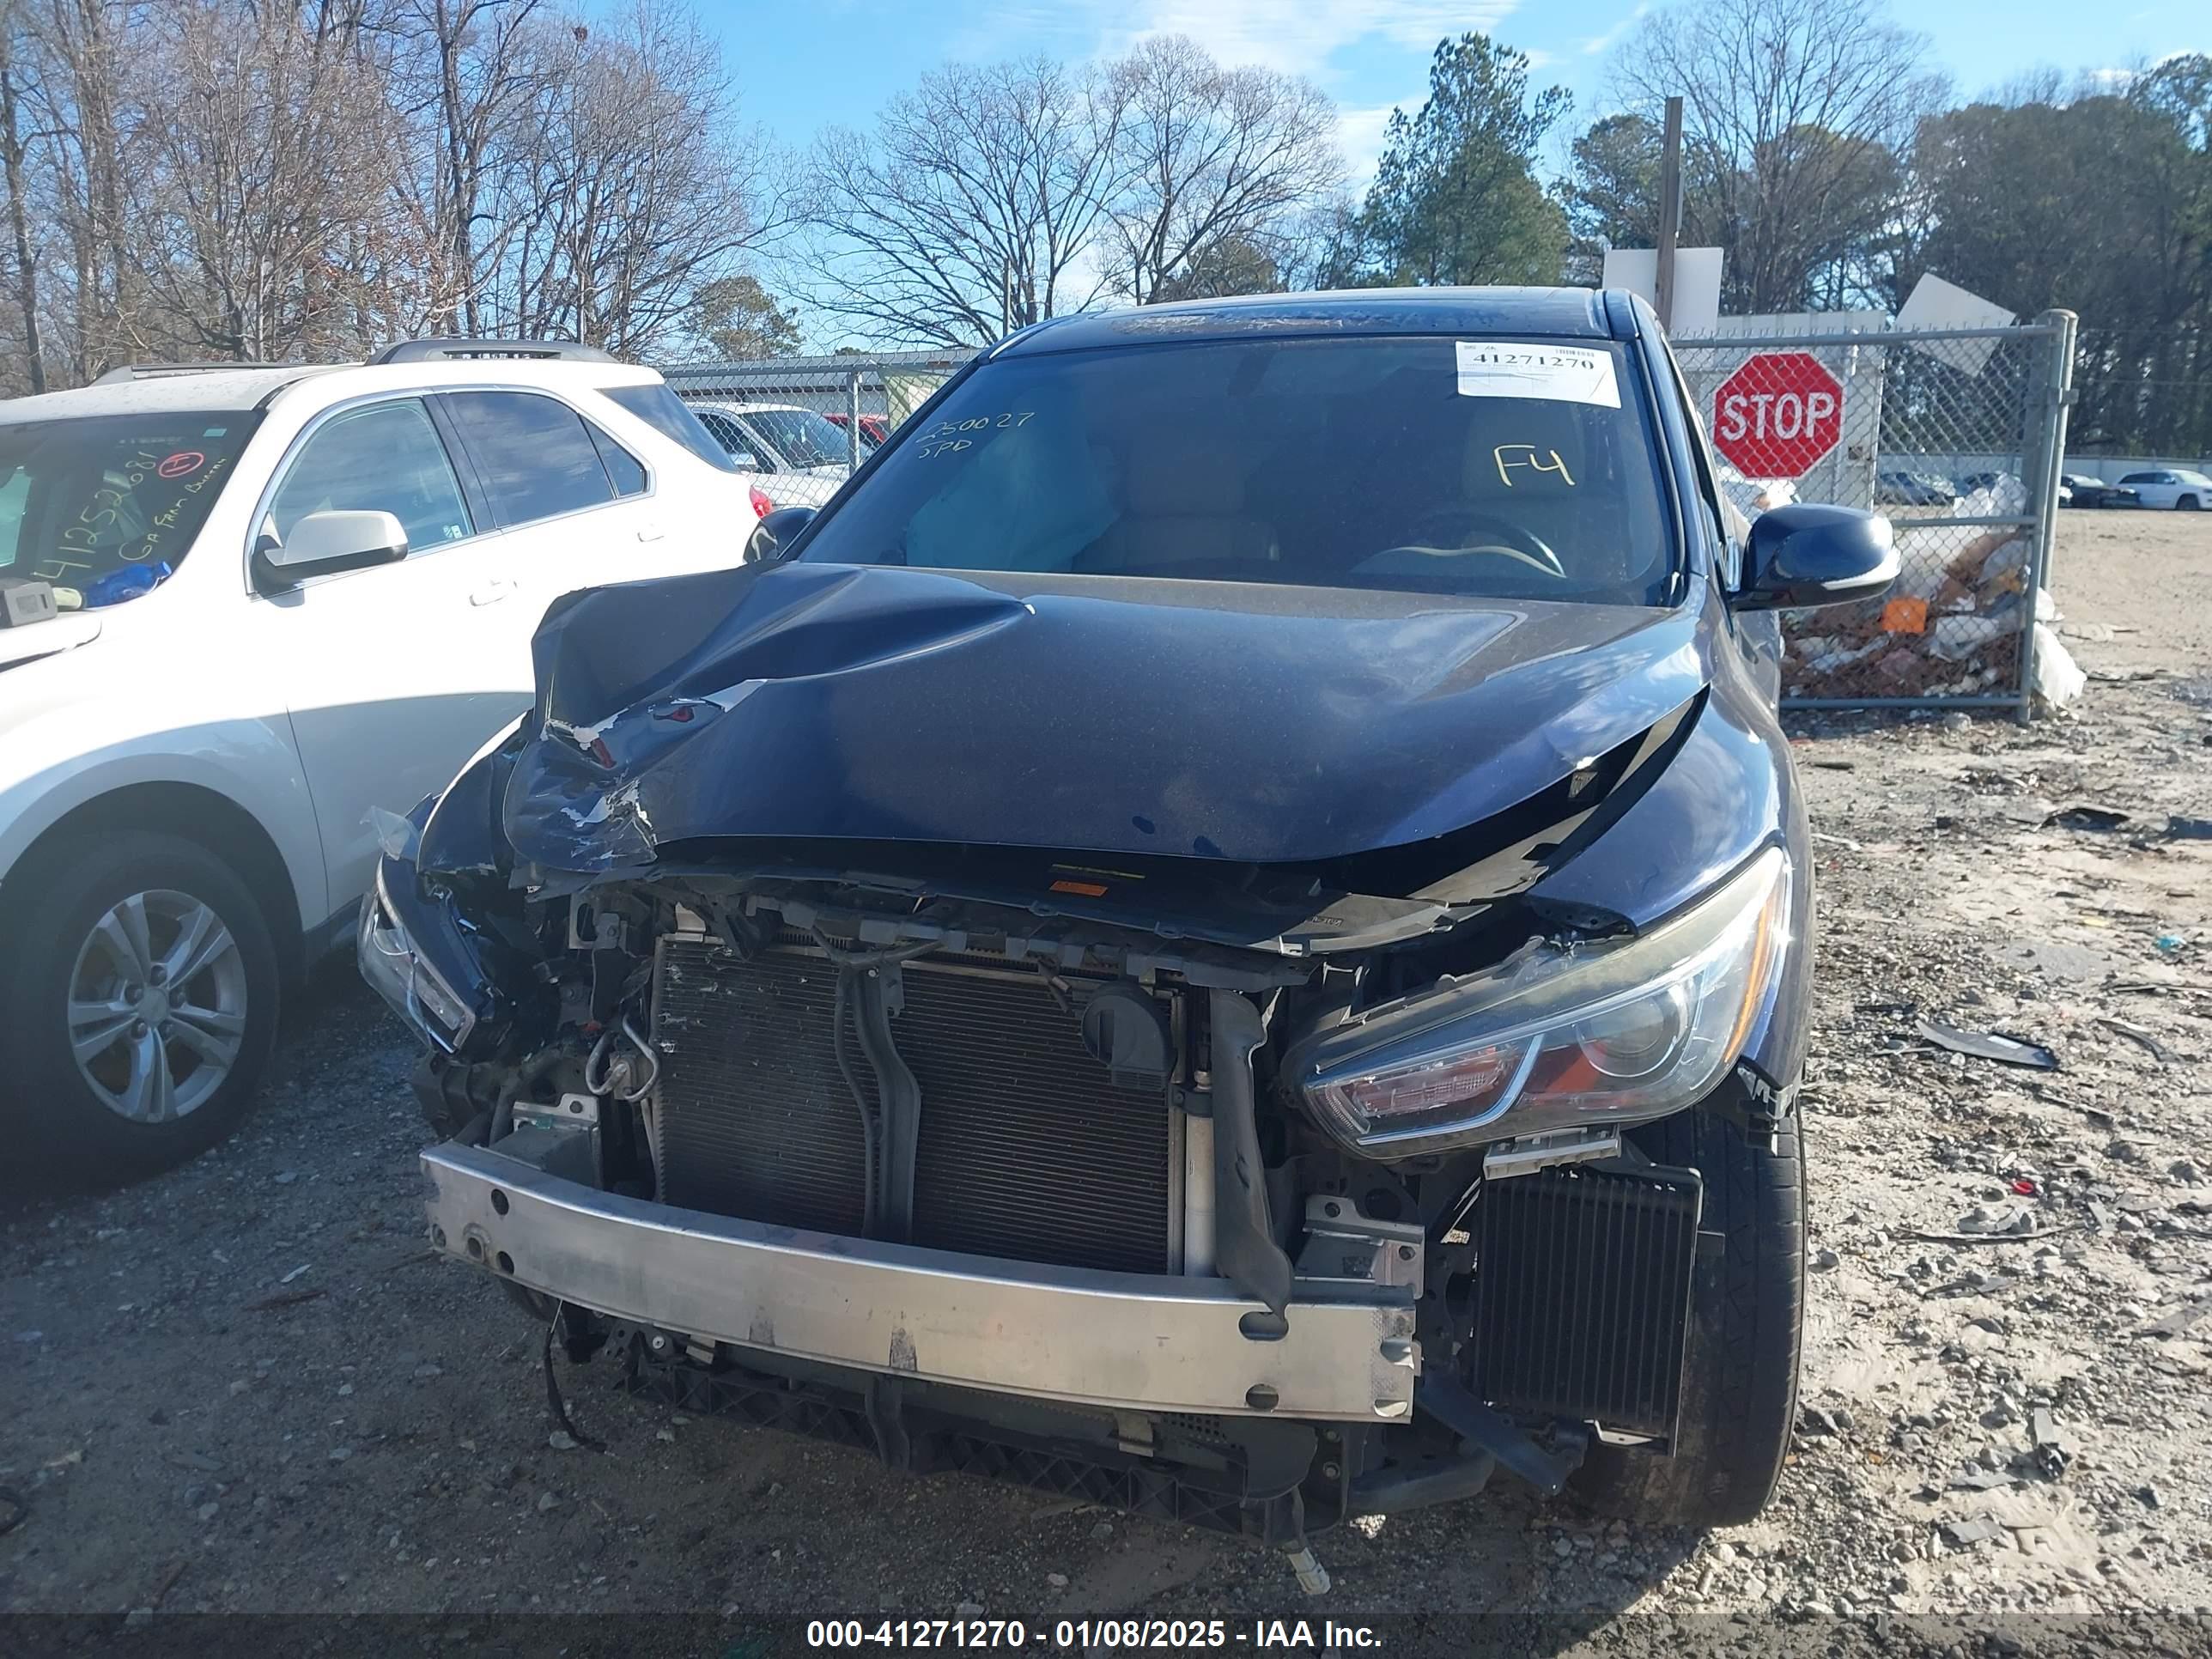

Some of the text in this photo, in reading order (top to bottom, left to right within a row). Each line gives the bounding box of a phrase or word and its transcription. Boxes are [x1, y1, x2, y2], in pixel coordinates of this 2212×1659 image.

[1473, 353, 1595, 371] 41271270
[1720, 392, 1836, 442] STOP
[1493, 443, 1577, 487] F4
